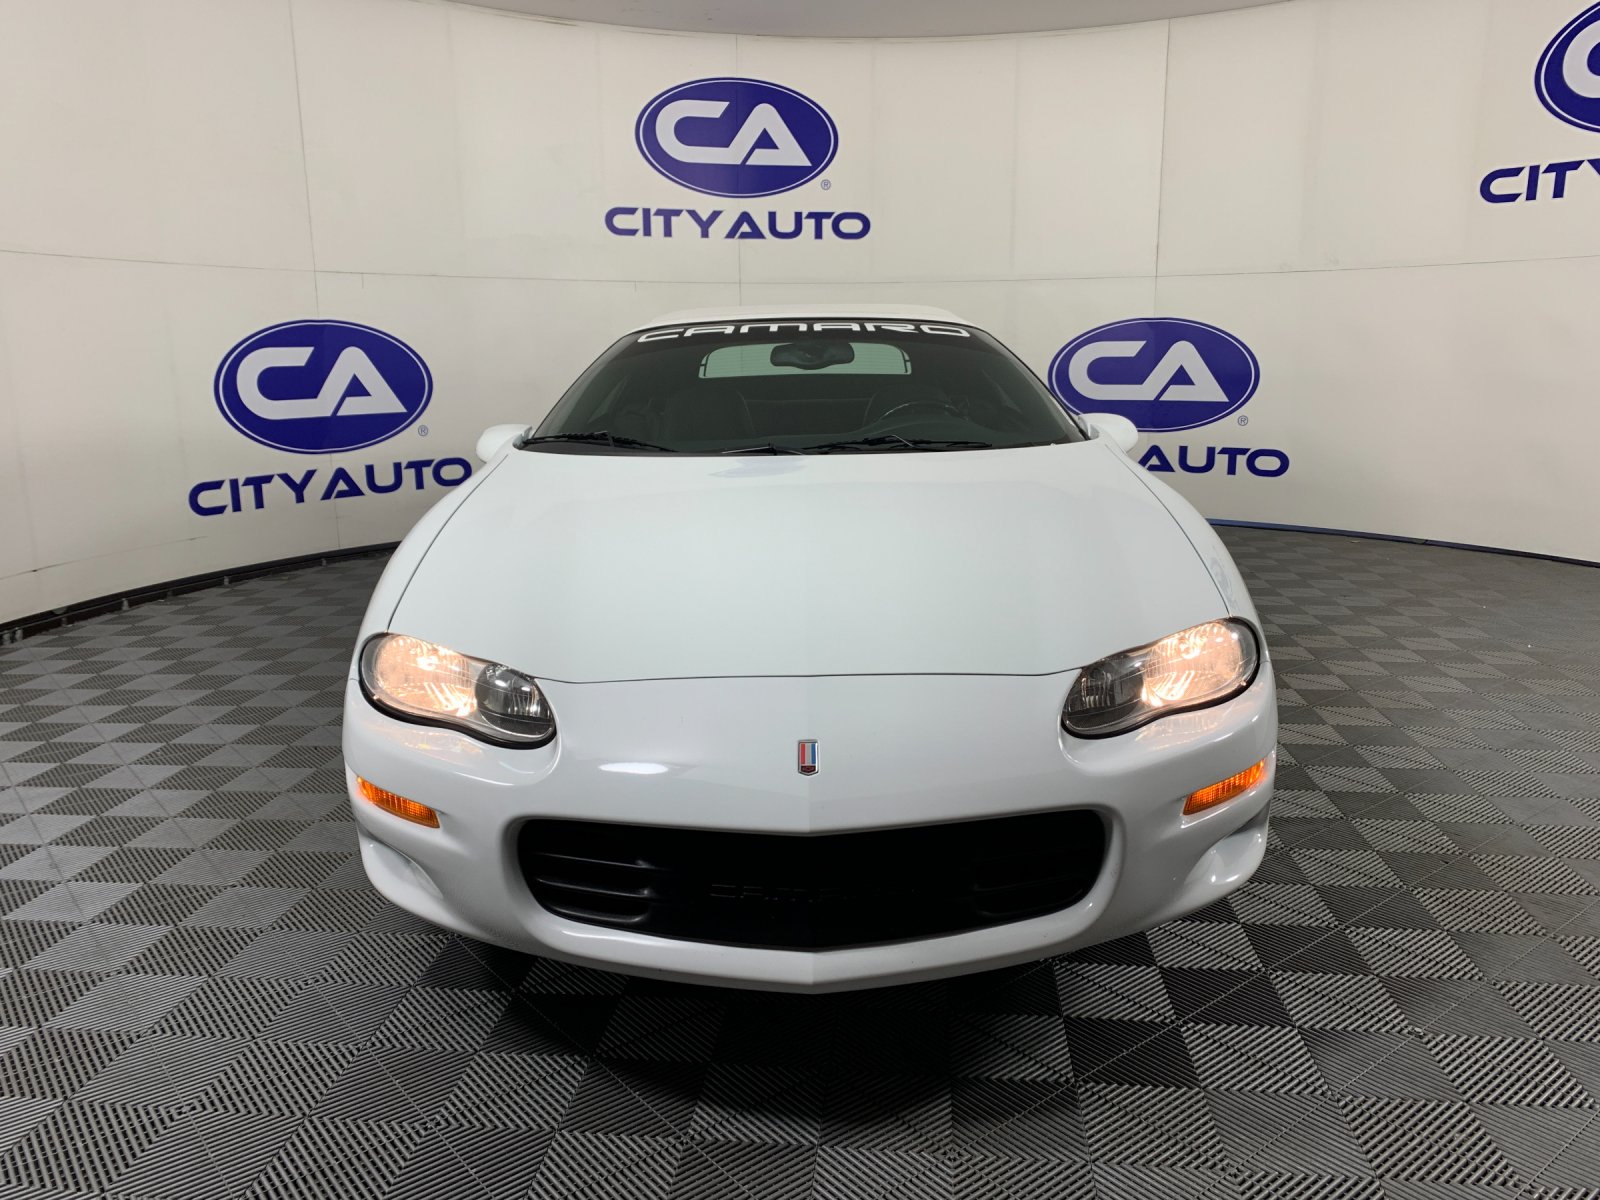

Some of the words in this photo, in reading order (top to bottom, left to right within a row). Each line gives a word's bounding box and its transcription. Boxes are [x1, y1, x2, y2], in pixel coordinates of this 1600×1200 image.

[655, 99, 812, 167] CA
[637, 322, 970, 343] CAMARO
[236, 346, 408, 421] CA
[1068, 340, 1230, 402] CA
[1137, 444, 1290, 478] AUTO
